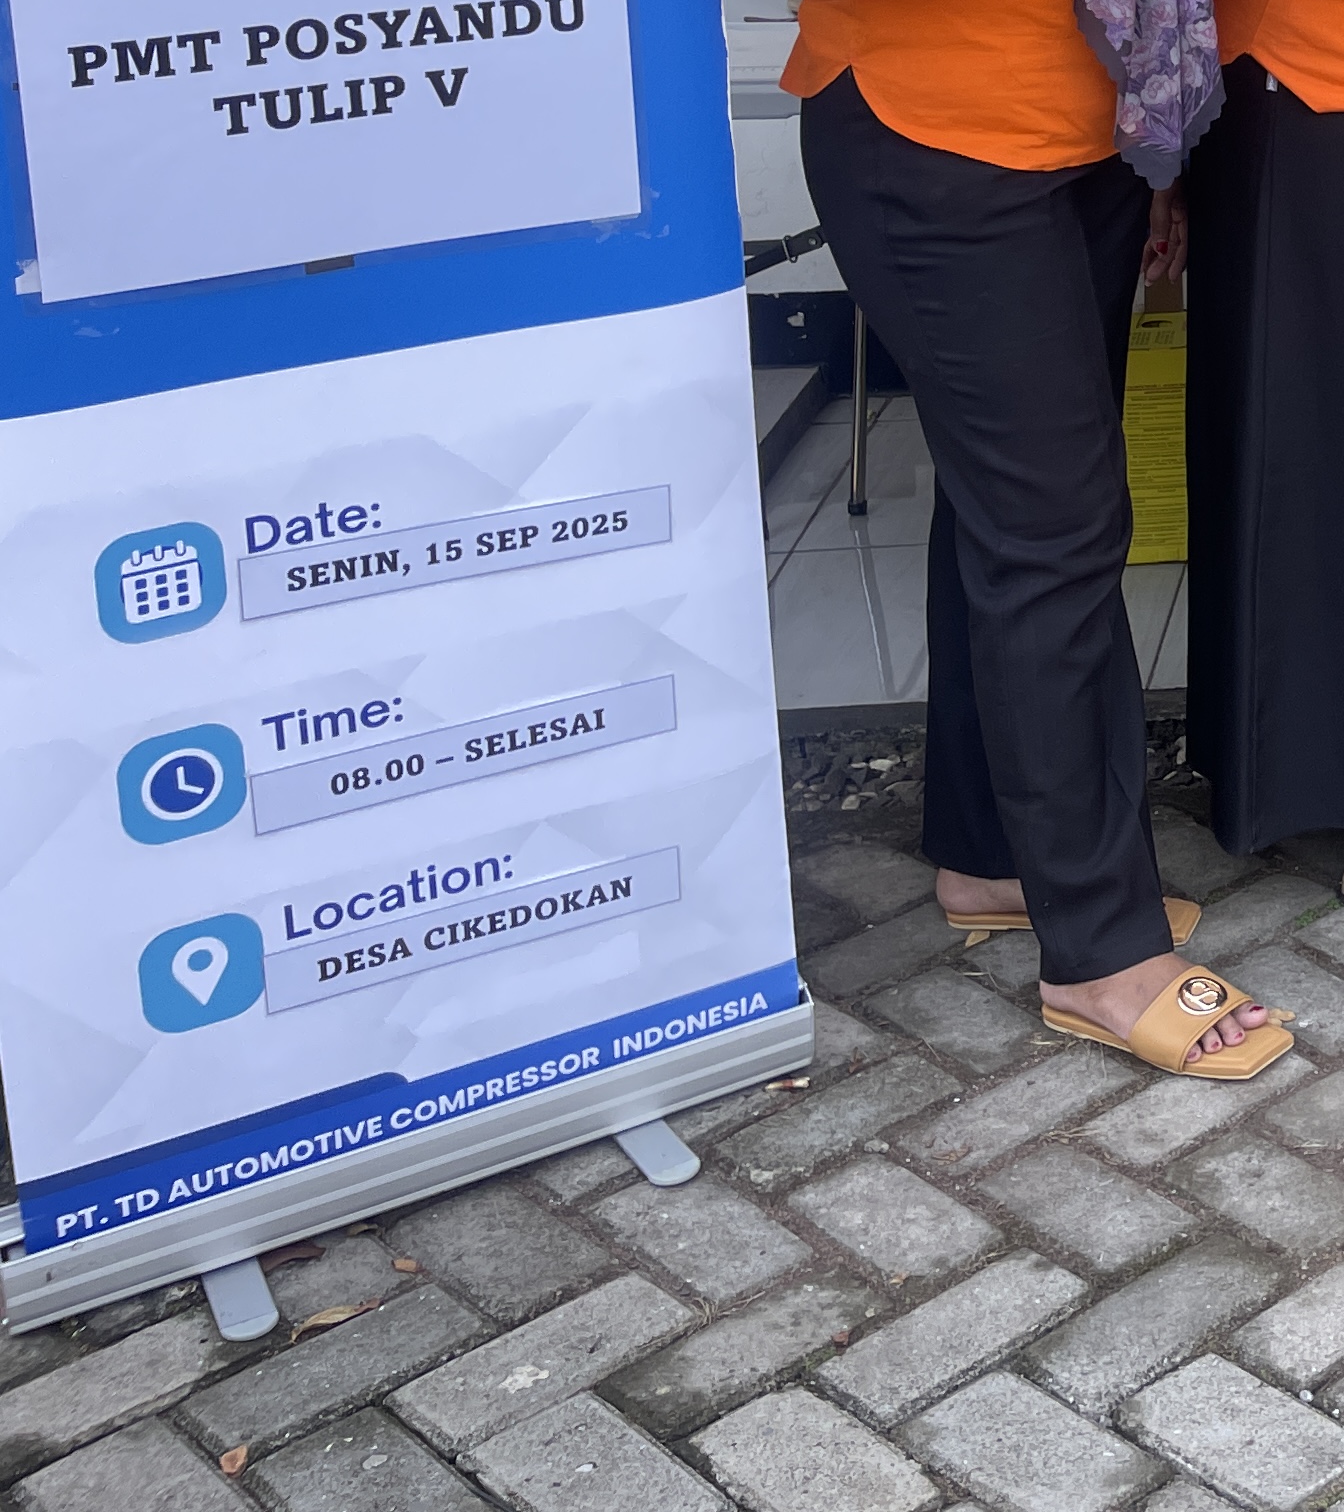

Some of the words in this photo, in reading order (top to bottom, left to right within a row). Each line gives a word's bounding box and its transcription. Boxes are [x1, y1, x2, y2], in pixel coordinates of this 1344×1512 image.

[67, 30, 221, 88] PMT
[212, 74, 406, 136] TULIP
[425, 67, 469, 107] V
[245, 496, 383, 555] Date:
[286, 548, 412, 593] SENIN,
[425, 536, 464, 567] 15
[476, 524, 540, 560] SEP
[551, 508, 630, 545] 2025
[262, 695, 405, 753] Time:
[330, 751, 426, 797] 08.00
[464, 707, 607, 764] SELESAI
[284, 850, 515, 942] Location:
[317, 938, 413, 984] DESA
[423, 875, 635, 952] CIKEDOKAN
[55, 1204, 109, 1239] PT.
[116, 1186, 162, 1223] TD
[167, 1116, 385, 1205] AUTOMOTIVE
[390, 1044, 602, 1131] COMPRESSOR
[612, 990, 770, 1060] INDONESIA
